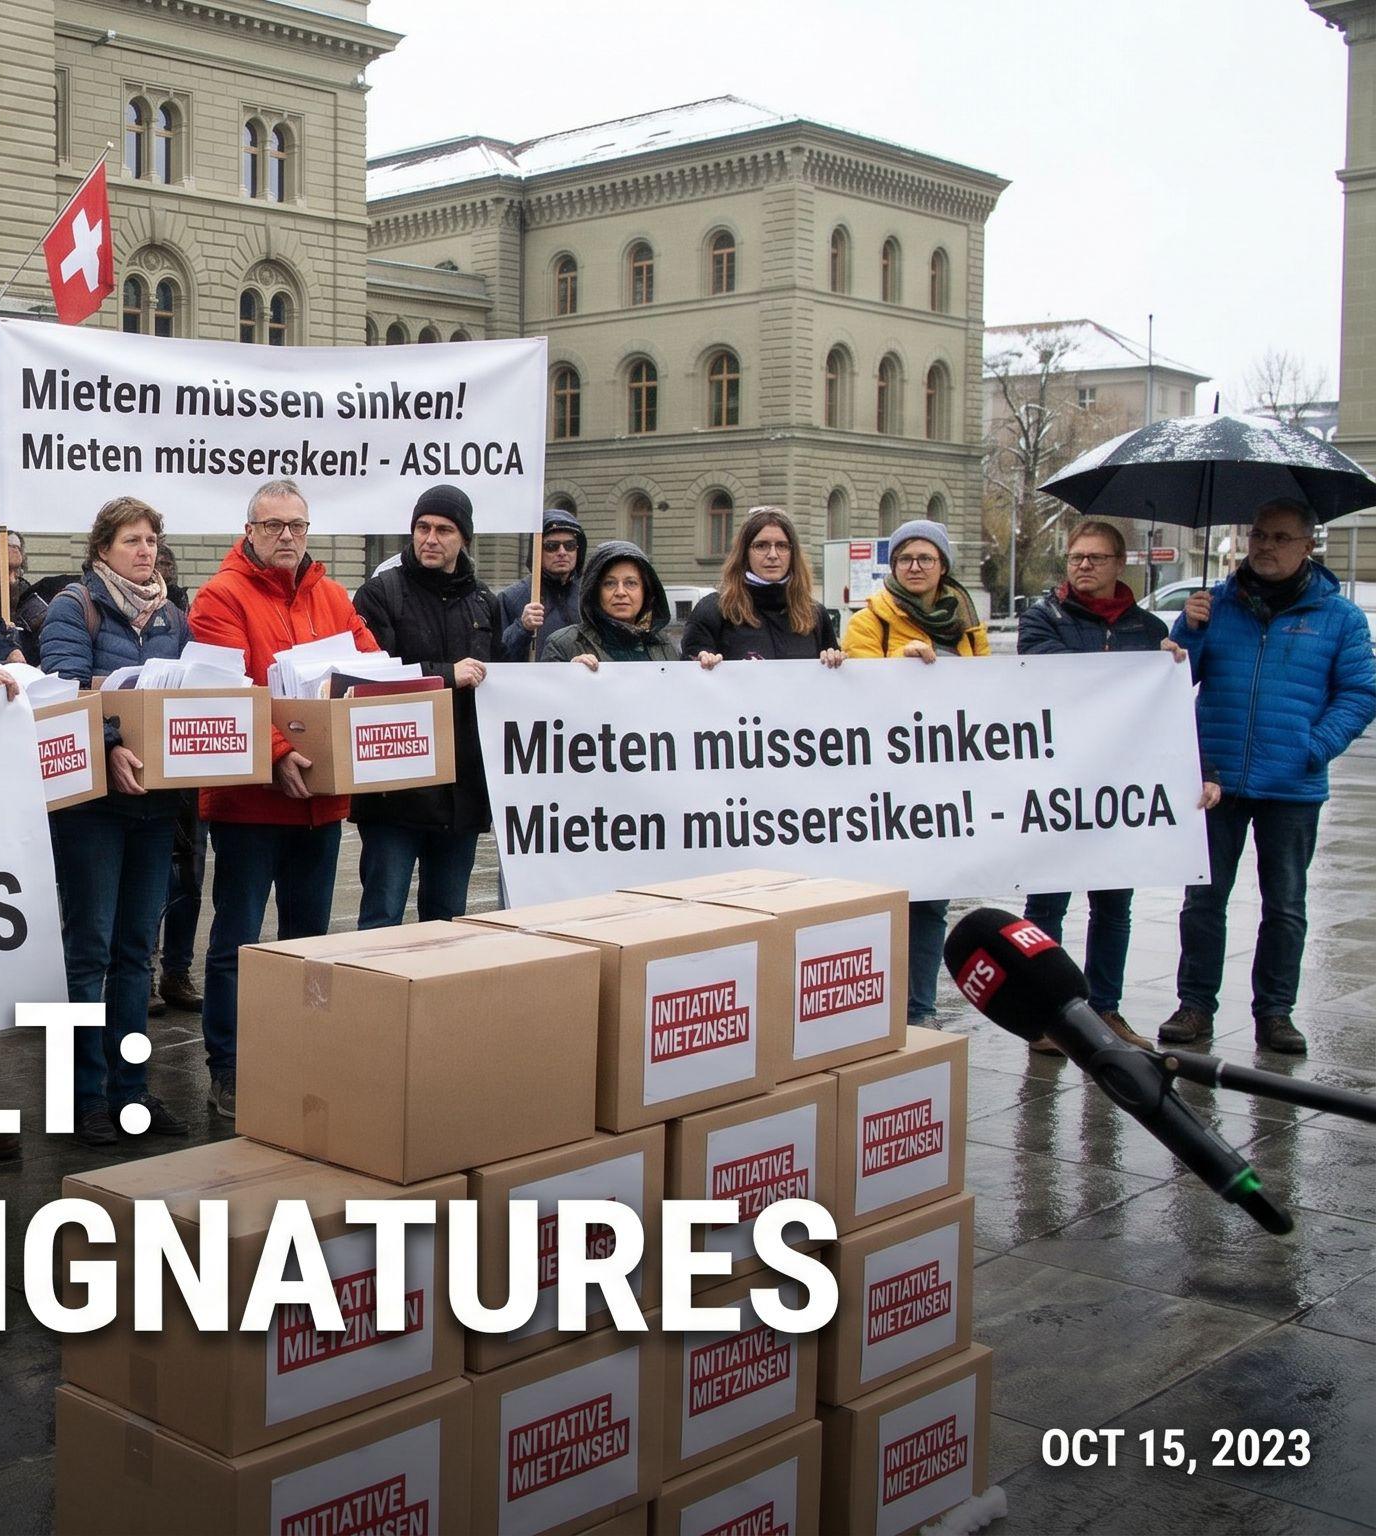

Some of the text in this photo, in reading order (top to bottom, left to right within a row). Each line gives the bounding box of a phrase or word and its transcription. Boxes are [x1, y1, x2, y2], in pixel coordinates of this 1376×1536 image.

[22, 367, 467, 420] Mieten müssen sinken!
[22, 433, 142, 473] Mieten
[399, 442, 524, 476] ASLOCA
[171, 736, 245, 753] MIETZINSEN
[172, 720, 234, 735] INITIATIVE
[358, 724, 416, 742] INITIATIVE
[359, 739, 427, 759] MIETZINSEN
[503, 709, 1055, 775] Mieten müssen sinken!
[41, 751, 85, 777] TZINSEN
[505, 803, 666, 855] Mieten
[683, 790, 975, 849] müssersiken!
[1020, 783, 1177, 834] ASLOCA
[803, 952, 870, 988] INITIATIVE
[962, 959, 996, 1003] RTS
[654, 986, 734, 1027] INITIATIVE
[802, 976, 882, 1016] MIETZINSEN
[654, 1012, 746, 1057] MIETZINSEN
[865, 1104, 930, 1144] INITIATIVE
[864, 1126, 941, 1172] MIETZINSEN
[716, 1150, 792, 1195] INITIATIVE
[871, 1265, 937, 1312] INITIATIVE
[870, 1287, 949, 1340] MIETZINSEN
[694, 1328, 773, 1380] INITIATIVE
[693, 1350, 787, 1410] MIETZINSEN
[512, 1400, 609, 1462] INITIATIVE
[886, 1420, 954, 1473] INITIATIVE
[512, 1425, 626, 1494] MIETZINSEN
[885, 1440, 965, 1499] MIETZINSEN
